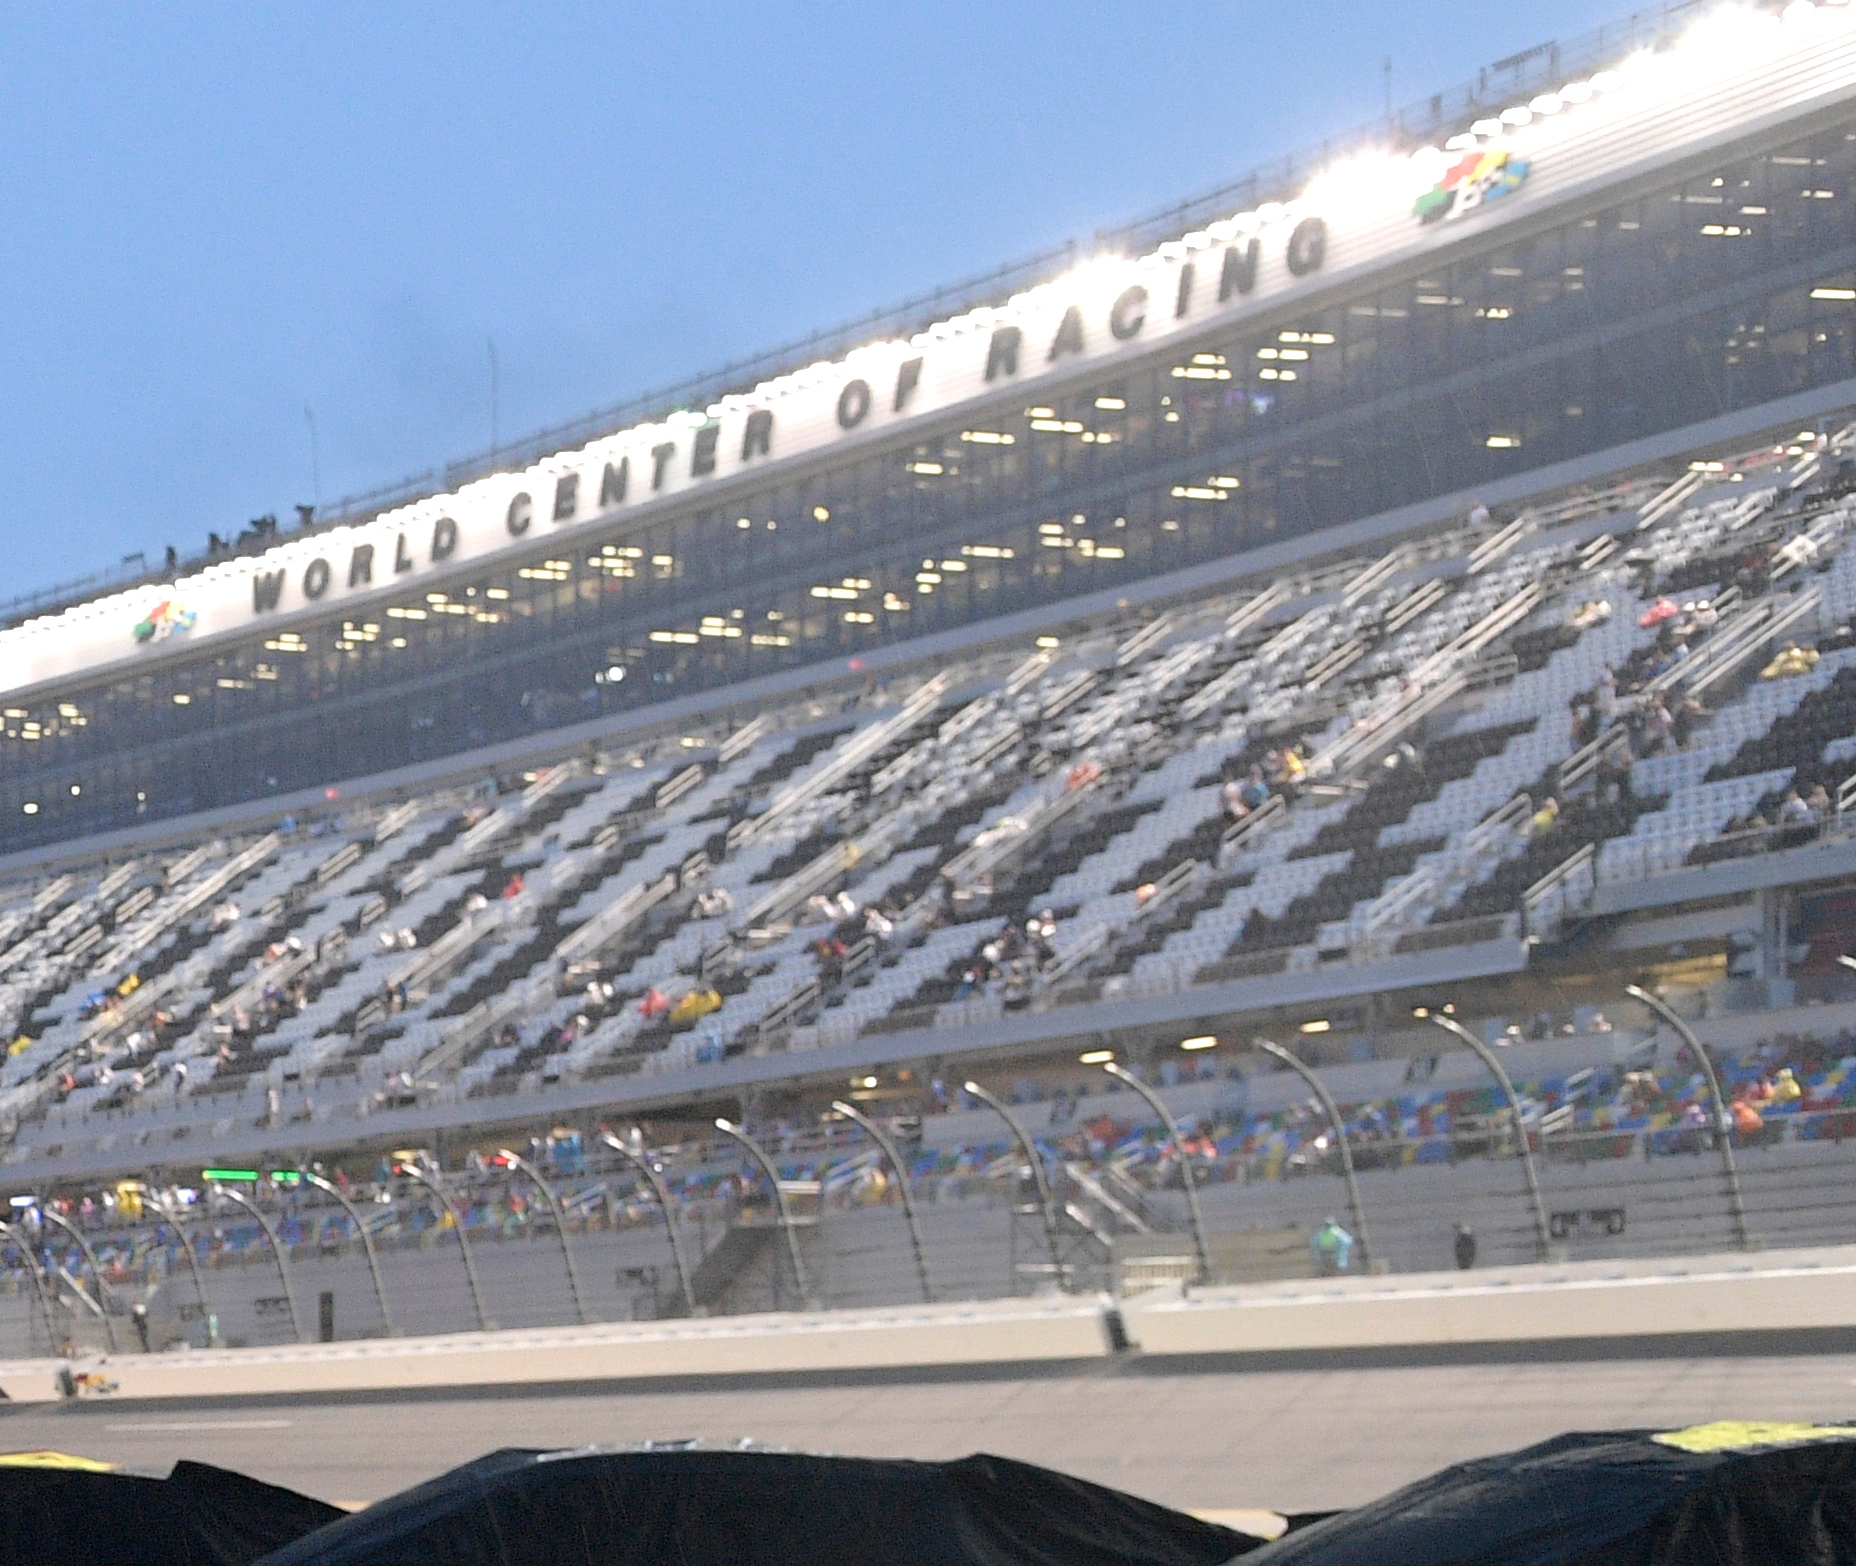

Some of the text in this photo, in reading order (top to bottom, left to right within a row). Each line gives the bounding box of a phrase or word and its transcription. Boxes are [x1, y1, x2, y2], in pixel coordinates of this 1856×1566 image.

[251, 216, 1327, 615] WORLD CENTER OF RACING
